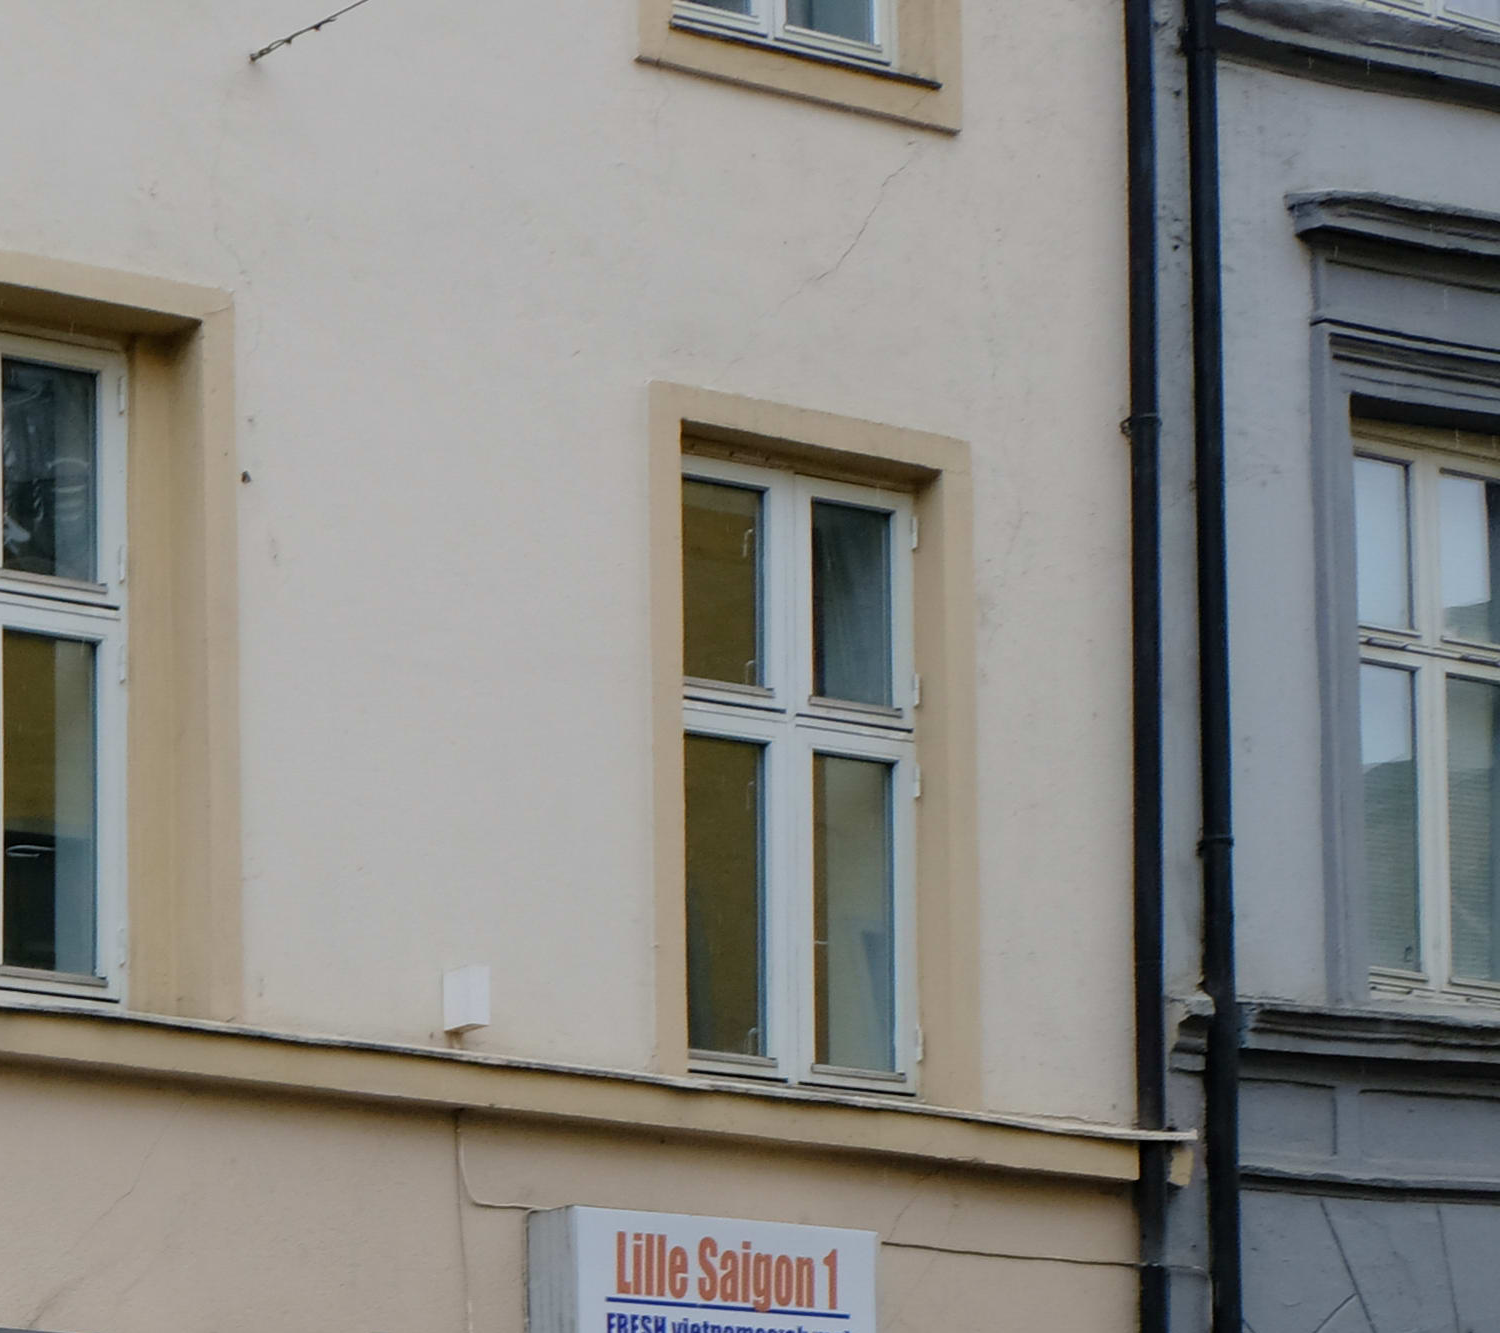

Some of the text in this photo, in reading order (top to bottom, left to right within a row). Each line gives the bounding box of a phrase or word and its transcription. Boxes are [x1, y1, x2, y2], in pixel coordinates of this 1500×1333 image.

[615, 1230, 838, 1313] Lille Saigon 1
